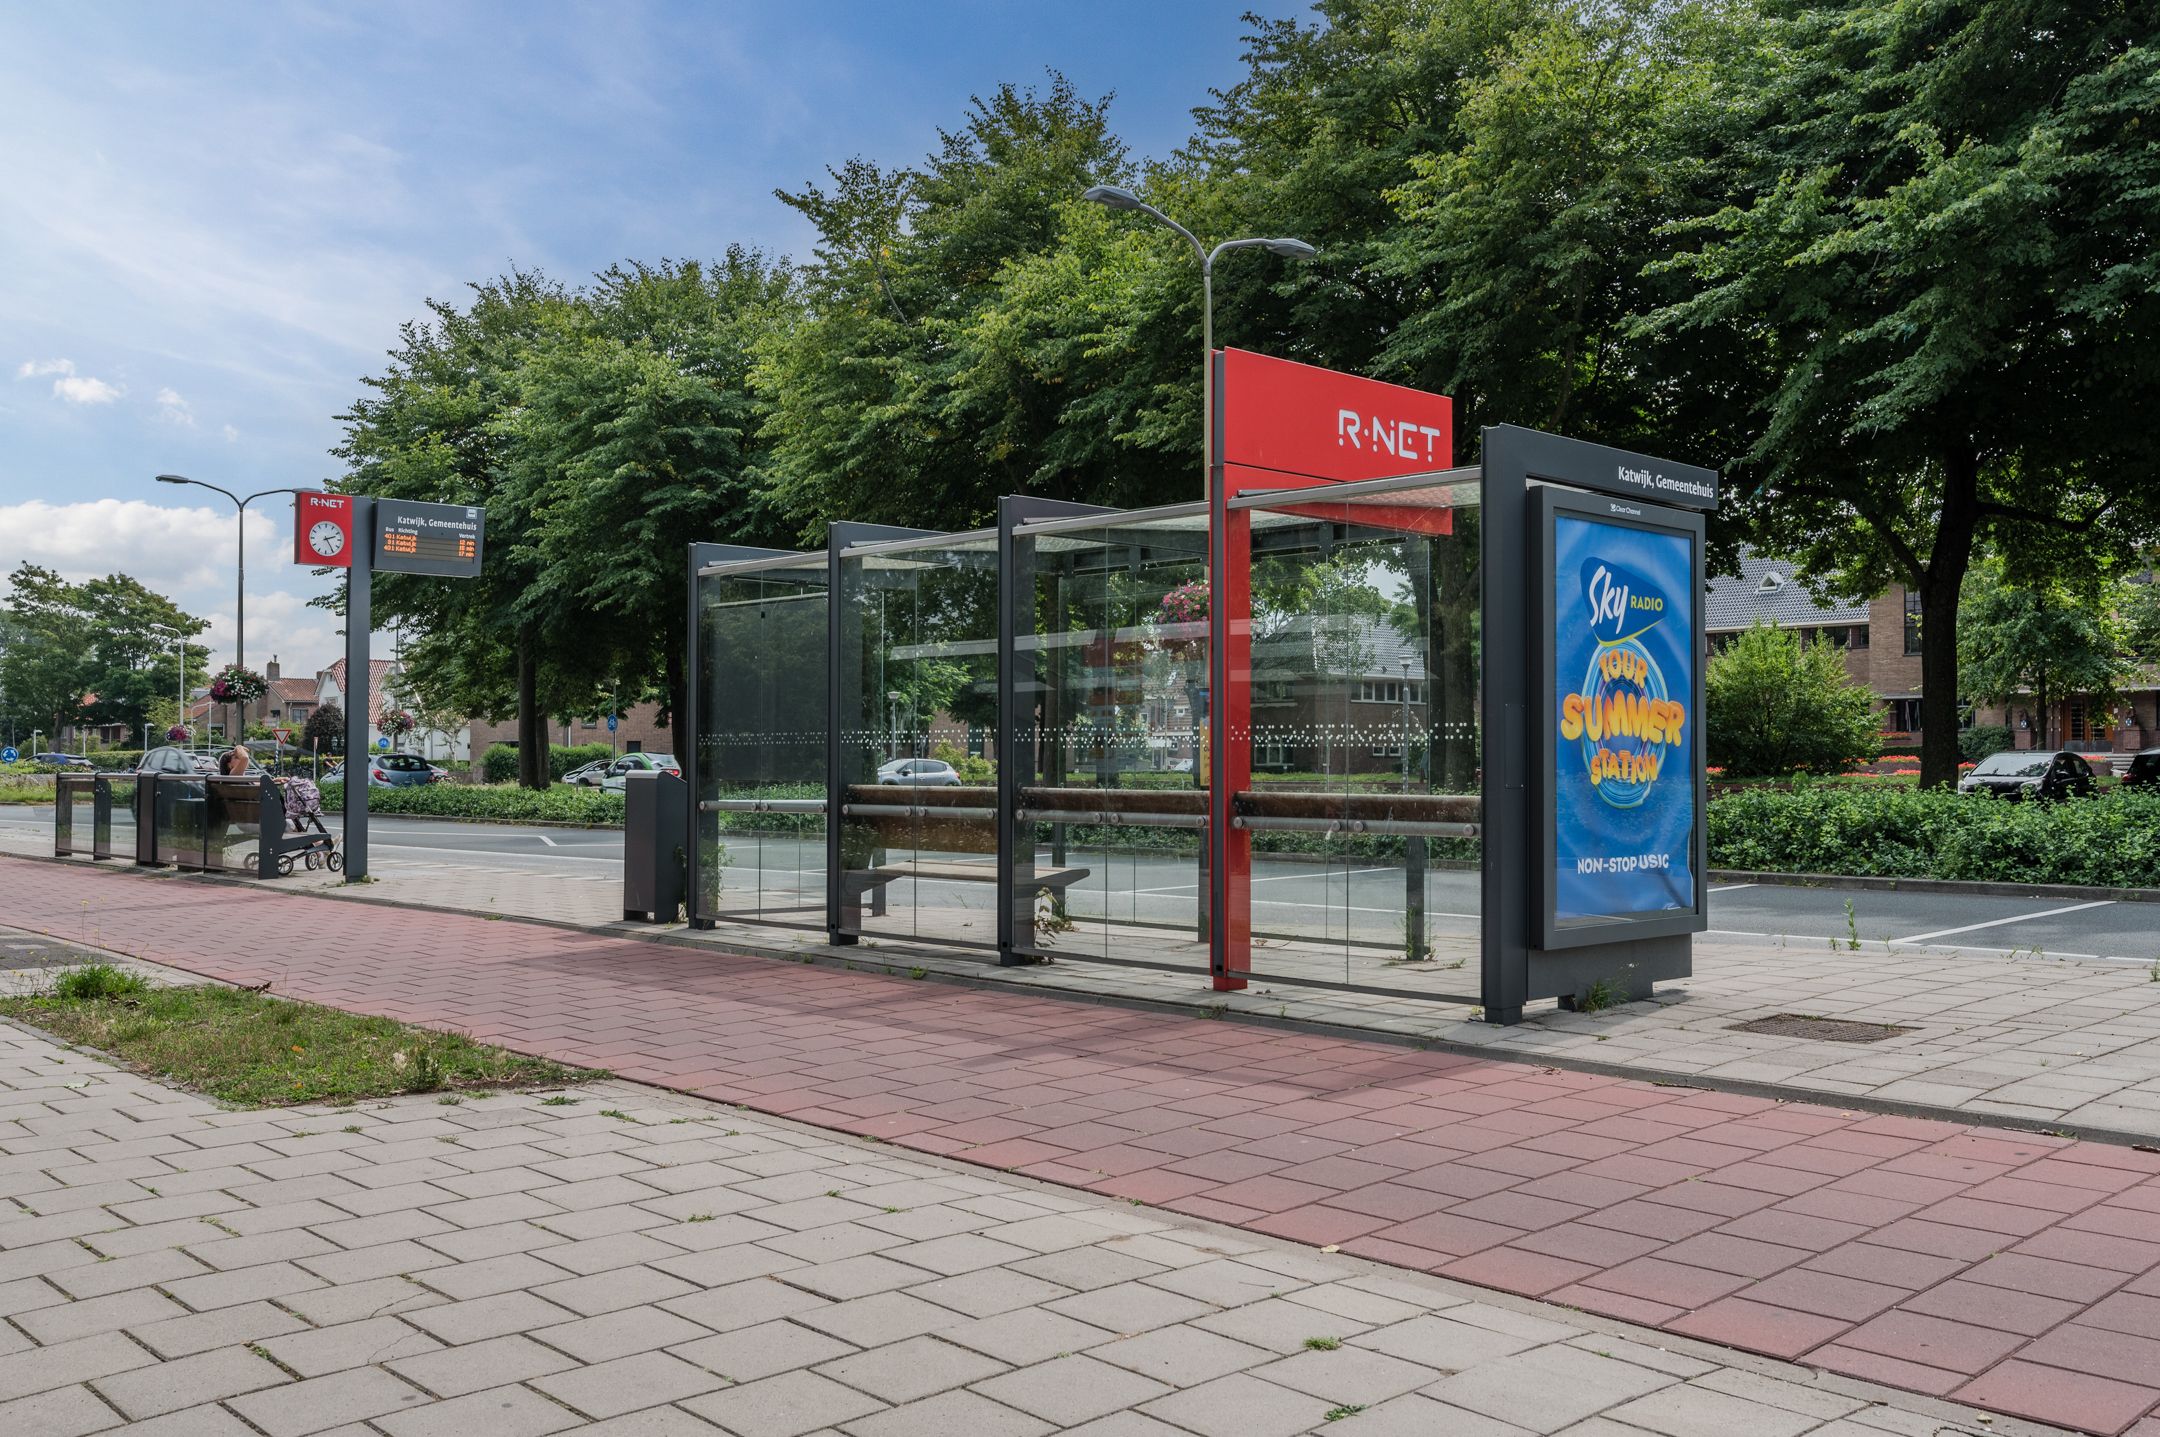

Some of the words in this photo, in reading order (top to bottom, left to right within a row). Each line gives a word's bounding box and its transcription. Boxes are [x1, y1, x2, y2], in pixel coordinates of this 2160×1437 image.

[1618, 466, 1655, 489] Katwijk,
[1655, 474, 1714, 499] Gemeentehuis
[397, 515, 427, 528] Katwijk,
[428, 518, 477, 531] Gemeentehuis
[397, 527, 418, 536] Richting
[1588, 565, 1629, 634] Sky
[1630, 595, 1664, 611] RADIO
[1598, 649, 1648, 689] YOUR
[1560, 690, 1686, 747] SUMMER
[1590, 748, 1658, 785] STATION
[1577, 856, 1637, 875] NON-STOP
